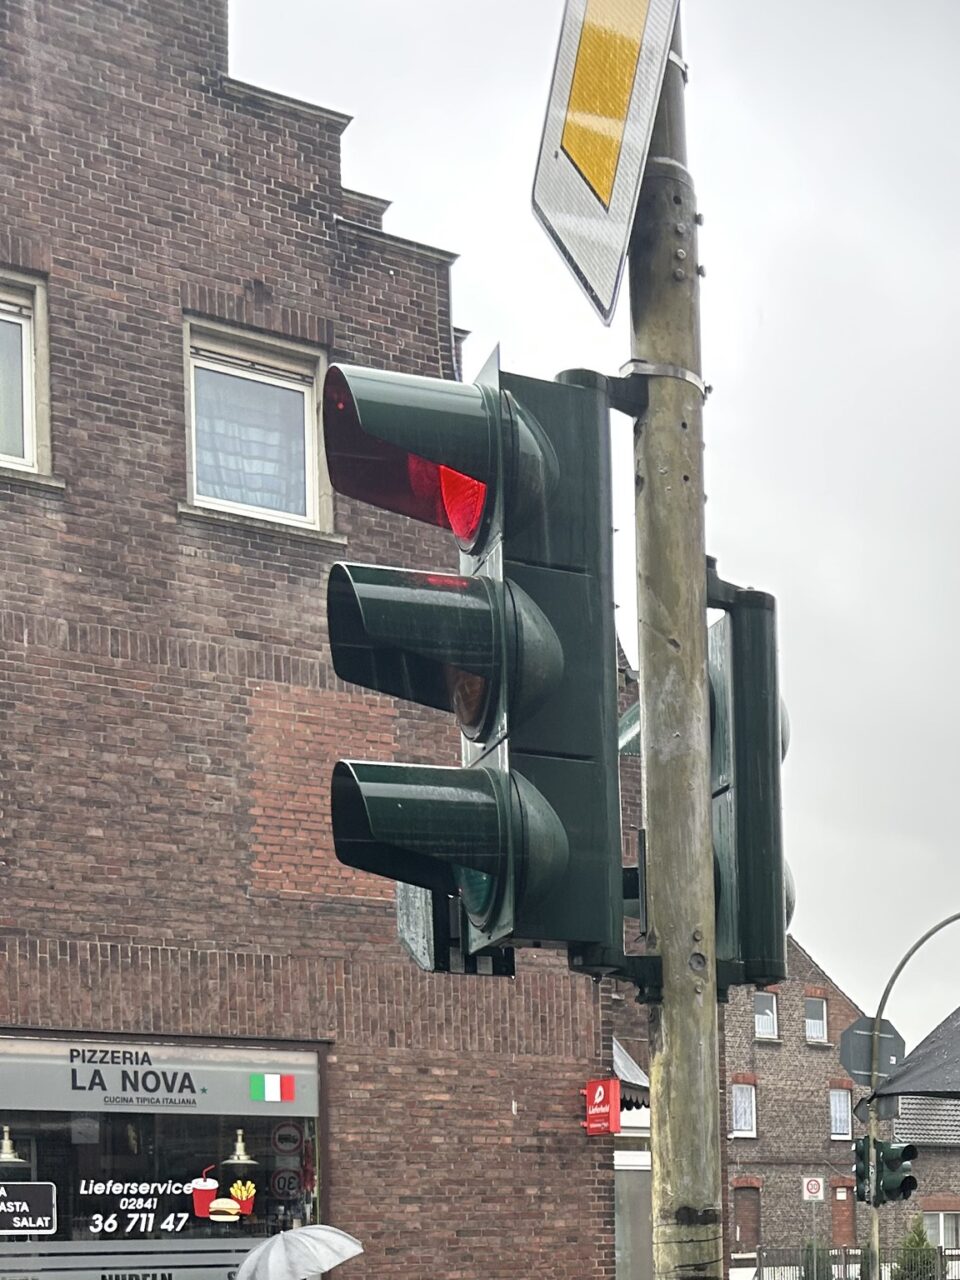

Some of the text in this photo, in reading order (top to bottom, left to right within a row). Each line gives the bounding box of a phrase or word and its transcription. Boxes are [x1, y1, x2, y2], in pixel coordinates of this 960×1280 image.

[69, 1048, 152, 1066] PIZZERIA
[71, 1068, 196, 1094] LA NOVA
[103, 1096, 134, 1104] CUCINA
[135, 1097, 161, 1105] TIPICA
[80, 1180, 193, 1195] Lieferservice
[119, 1197, 158, 1210] 02841
[12, 1216, 51, 1228] SALAT
[89, 1212, 190, 1233] 36 711 47
